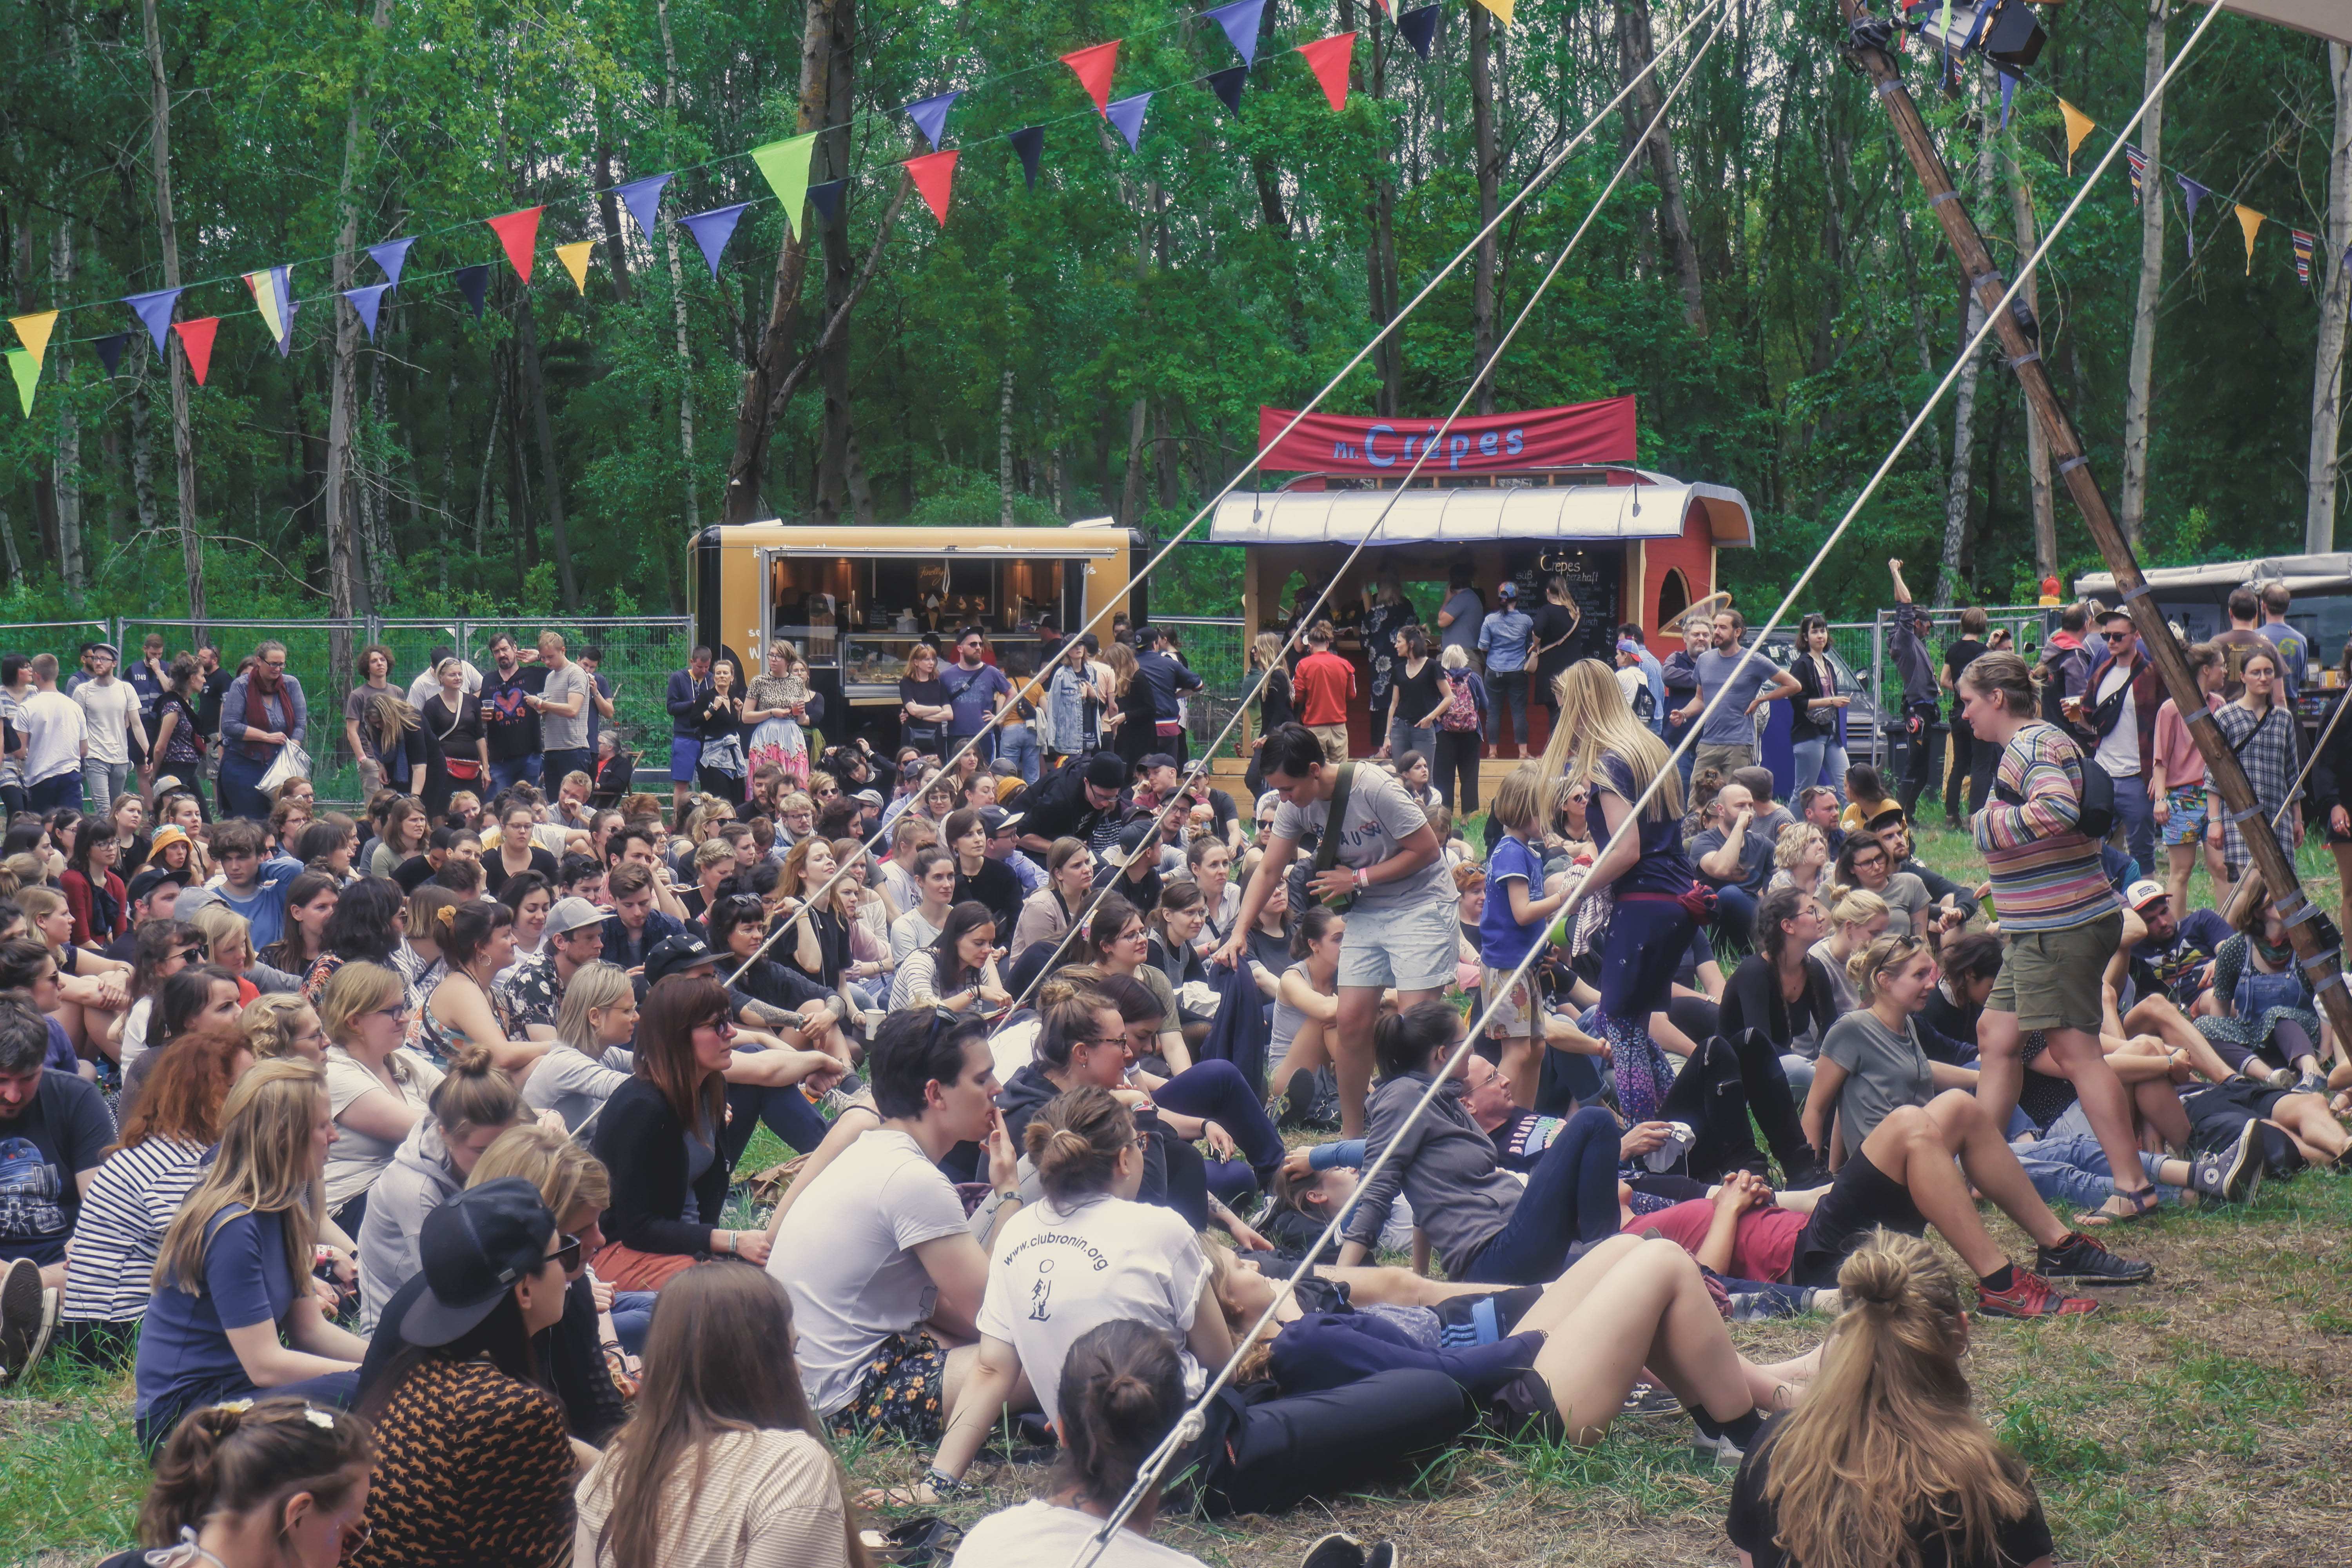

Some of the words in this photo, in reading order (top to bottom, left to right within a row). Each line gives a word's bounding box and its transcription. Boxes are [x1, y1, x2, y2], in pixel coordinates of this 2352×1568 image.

[1334, 442, 1359, 459] Mr.
[1365, 425, 1524, 470] Crêpes
[1566, 572, 1599, 584] herzhaft
[1509, 1114, 1541, 1156] BERMUD
[1004, 1232, 1109, 1271] www.clubronin.org
